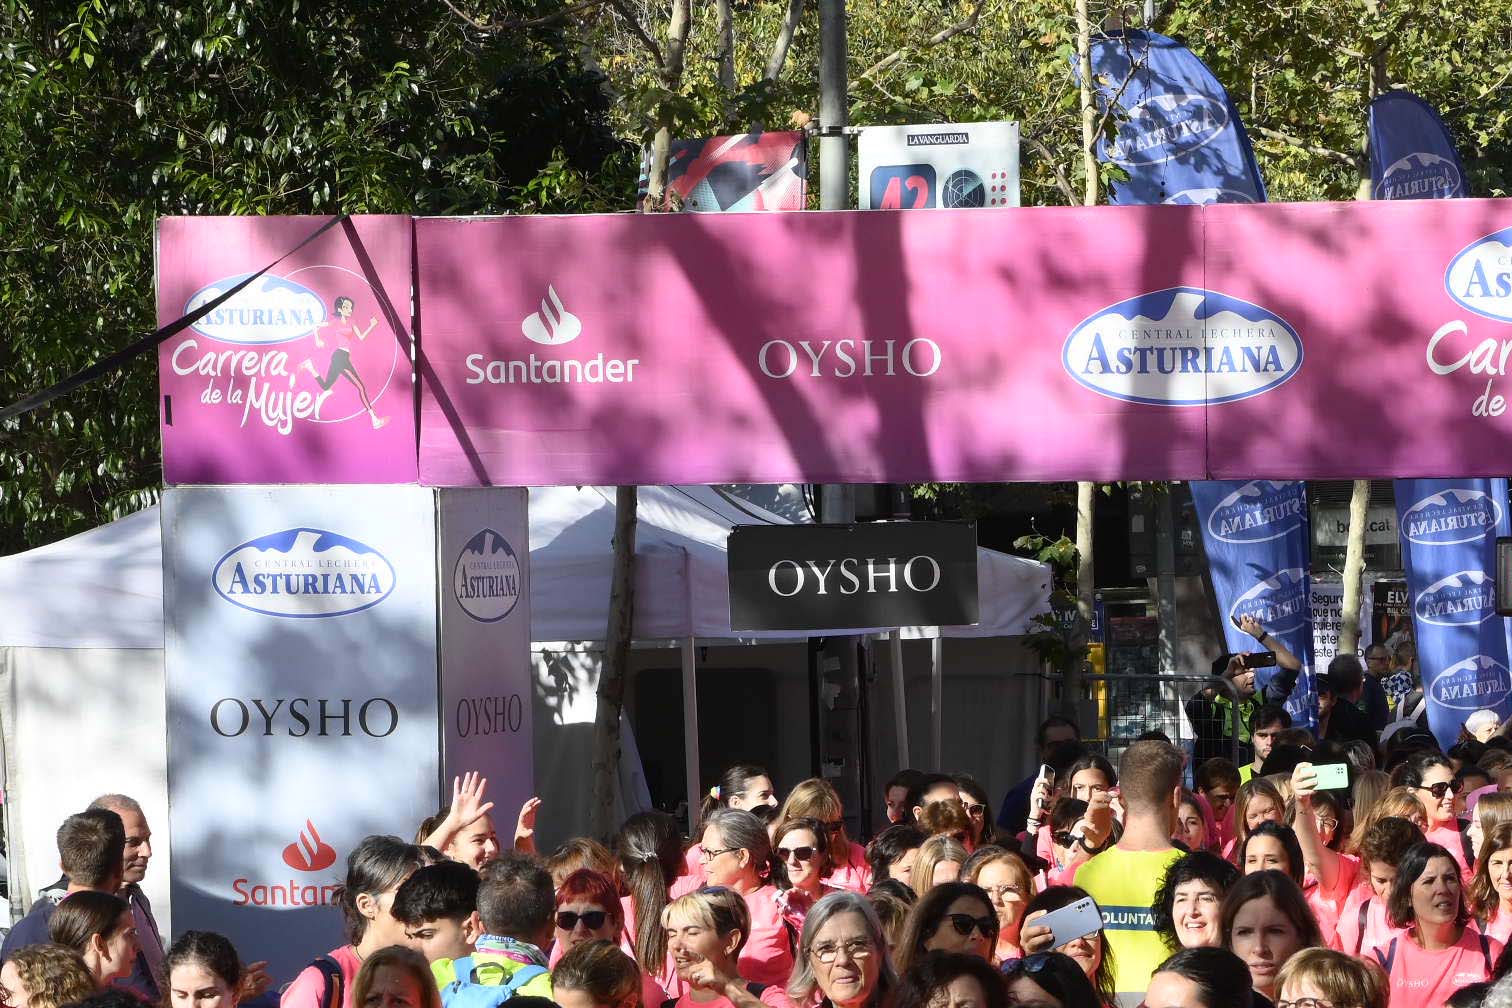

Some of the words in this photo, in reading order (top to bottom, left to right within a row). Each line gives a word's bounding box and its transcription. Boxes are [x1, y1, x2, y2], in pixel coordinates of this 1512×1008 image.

[1119, 328, 1193, 339] CENTRAL
[1201, 328, 1277, 339] LECHERA
[171, 339, 288, 376] Carrera
[466, 353, 639, 384] Santander
[758, 337, 941, 378] OYSHO
[1082, 333, 1285, 376] ASTURIANA
[200, 378, 222, 405] de
[227, 378, 243, 405] la
[240, 373, 334, 436] Mujer
[1471, 379, 1507, 417] de
[226, 562, 383, 596] ASTURIANA
[459, 564, 518, 599] ASTURIANA
[769, 555, 941, 597] OYSHO
[210, 697, 398, 738] OYSHO
[456, 693, 522, 738] OYSHO
[232, 878, 337, 907] Santan
[1101, 911, 1156, 925] OLUNTA
